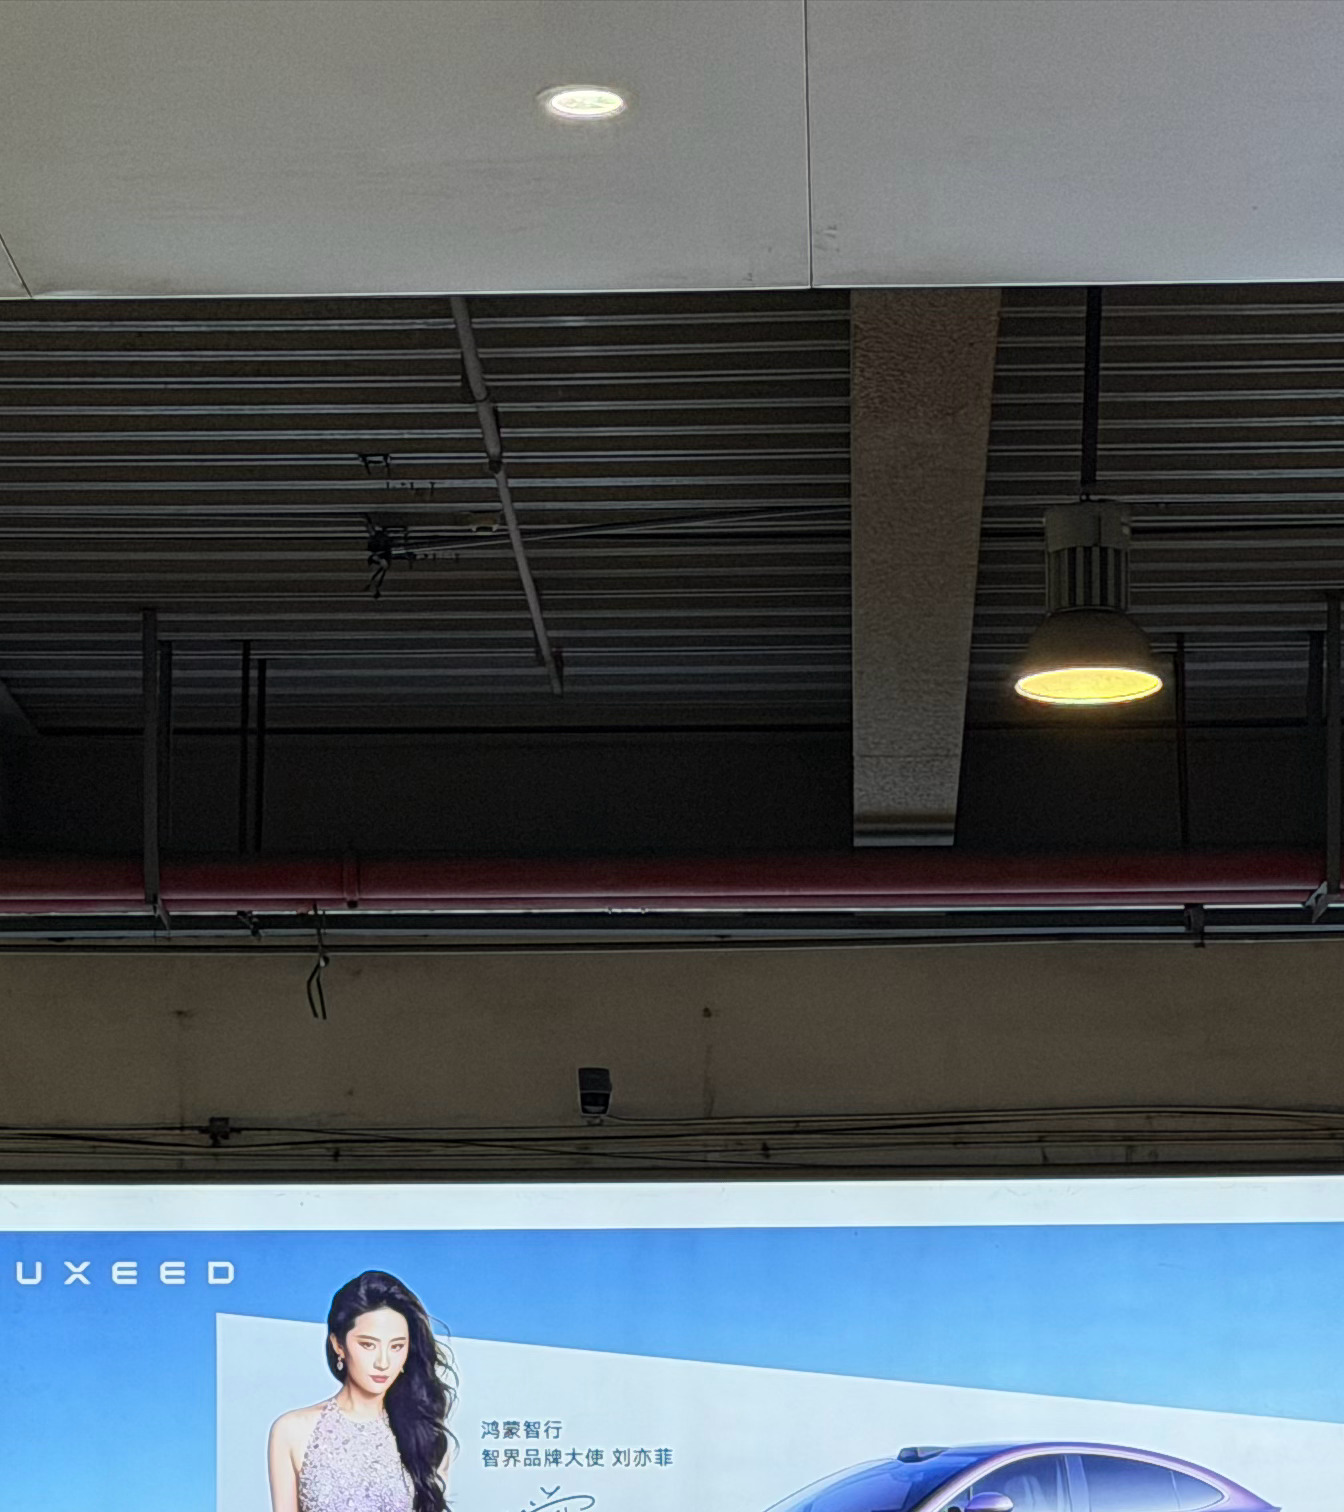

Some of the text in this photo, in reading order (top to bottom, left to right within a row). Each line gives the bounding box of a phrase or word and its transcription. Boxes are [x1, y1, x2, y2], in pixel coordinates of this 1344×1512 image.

[481, 1420, 563, 1440] 鸿蒙智行
[482, 1448, 674, 1468] 智界品牌大使 刘亦菲
